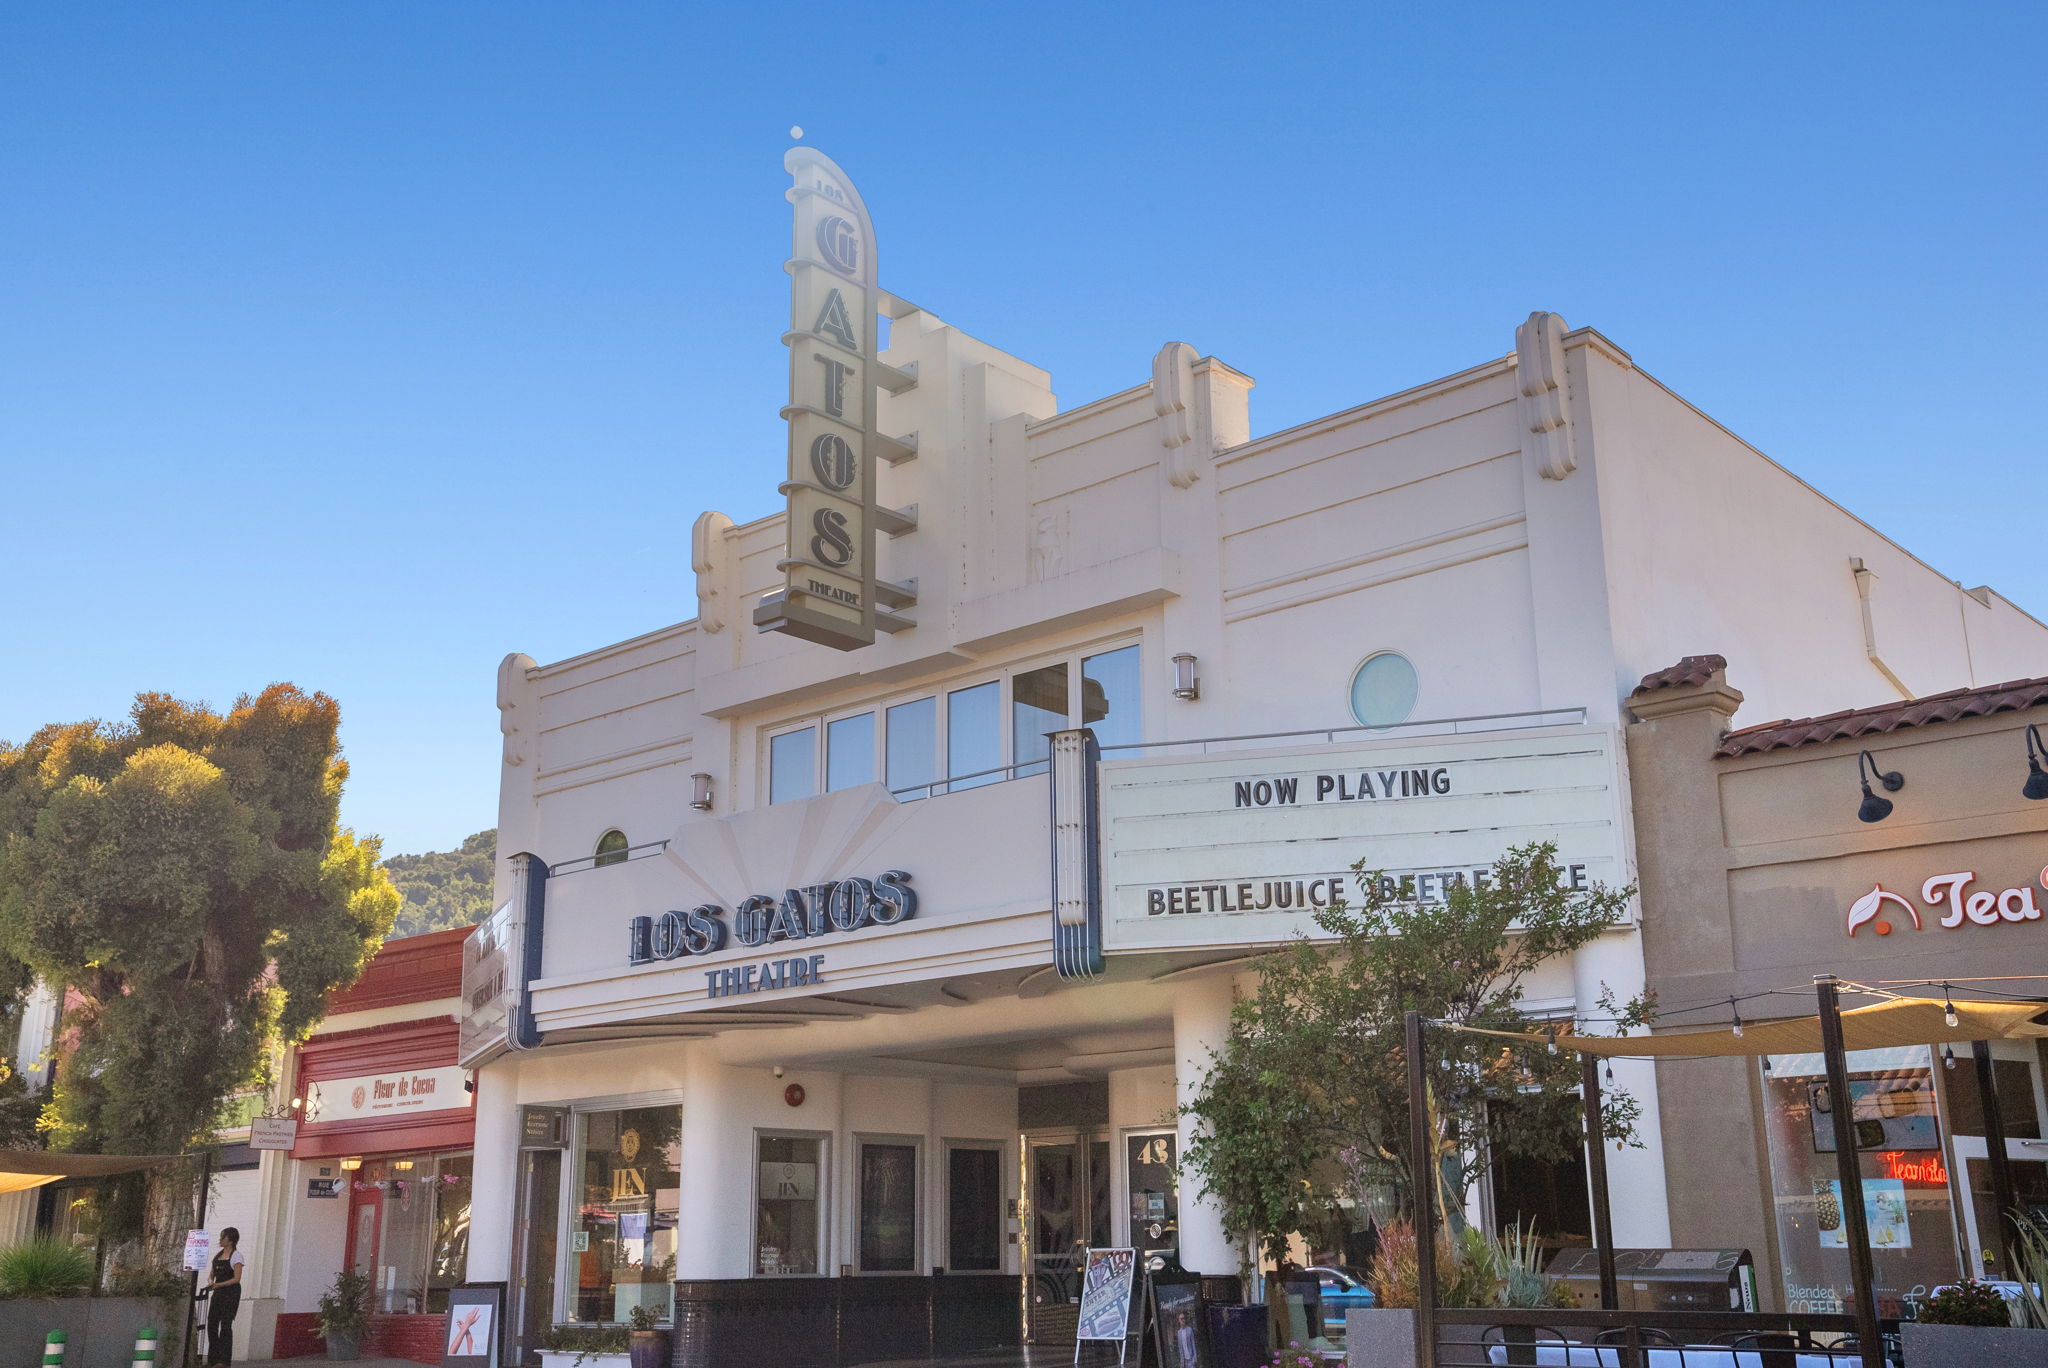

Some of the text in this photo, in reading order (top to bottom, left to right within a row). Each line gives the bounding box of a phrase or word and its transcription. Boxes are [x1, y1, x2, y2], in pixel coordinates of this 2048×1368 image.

[811, 216, 858, 568] GATOS
[808, 579, 859, 605] THEATRE
[1235, 767, 1451, 808] NOW PLAYING
[1147, 877, 1344, 916] BEETLEJUICE
[1922, 871, 2043, 929] Tea
[629, 869, 919, 967] LOS GATOS
[704, 954, 825, 999] THEATRE
[374, 1079, 395, 1099] Fleur
[398, 1077, 408, 1097] de
[1137, 1138, 1169, 1165] 43
[609, 1167, 647, 1204] JEN
[777, 1182, 800, 1199] JEN
[1787, 1284, 1835, 1299] Blended
[1788, 1300, 1844, 1314] COFFEE
